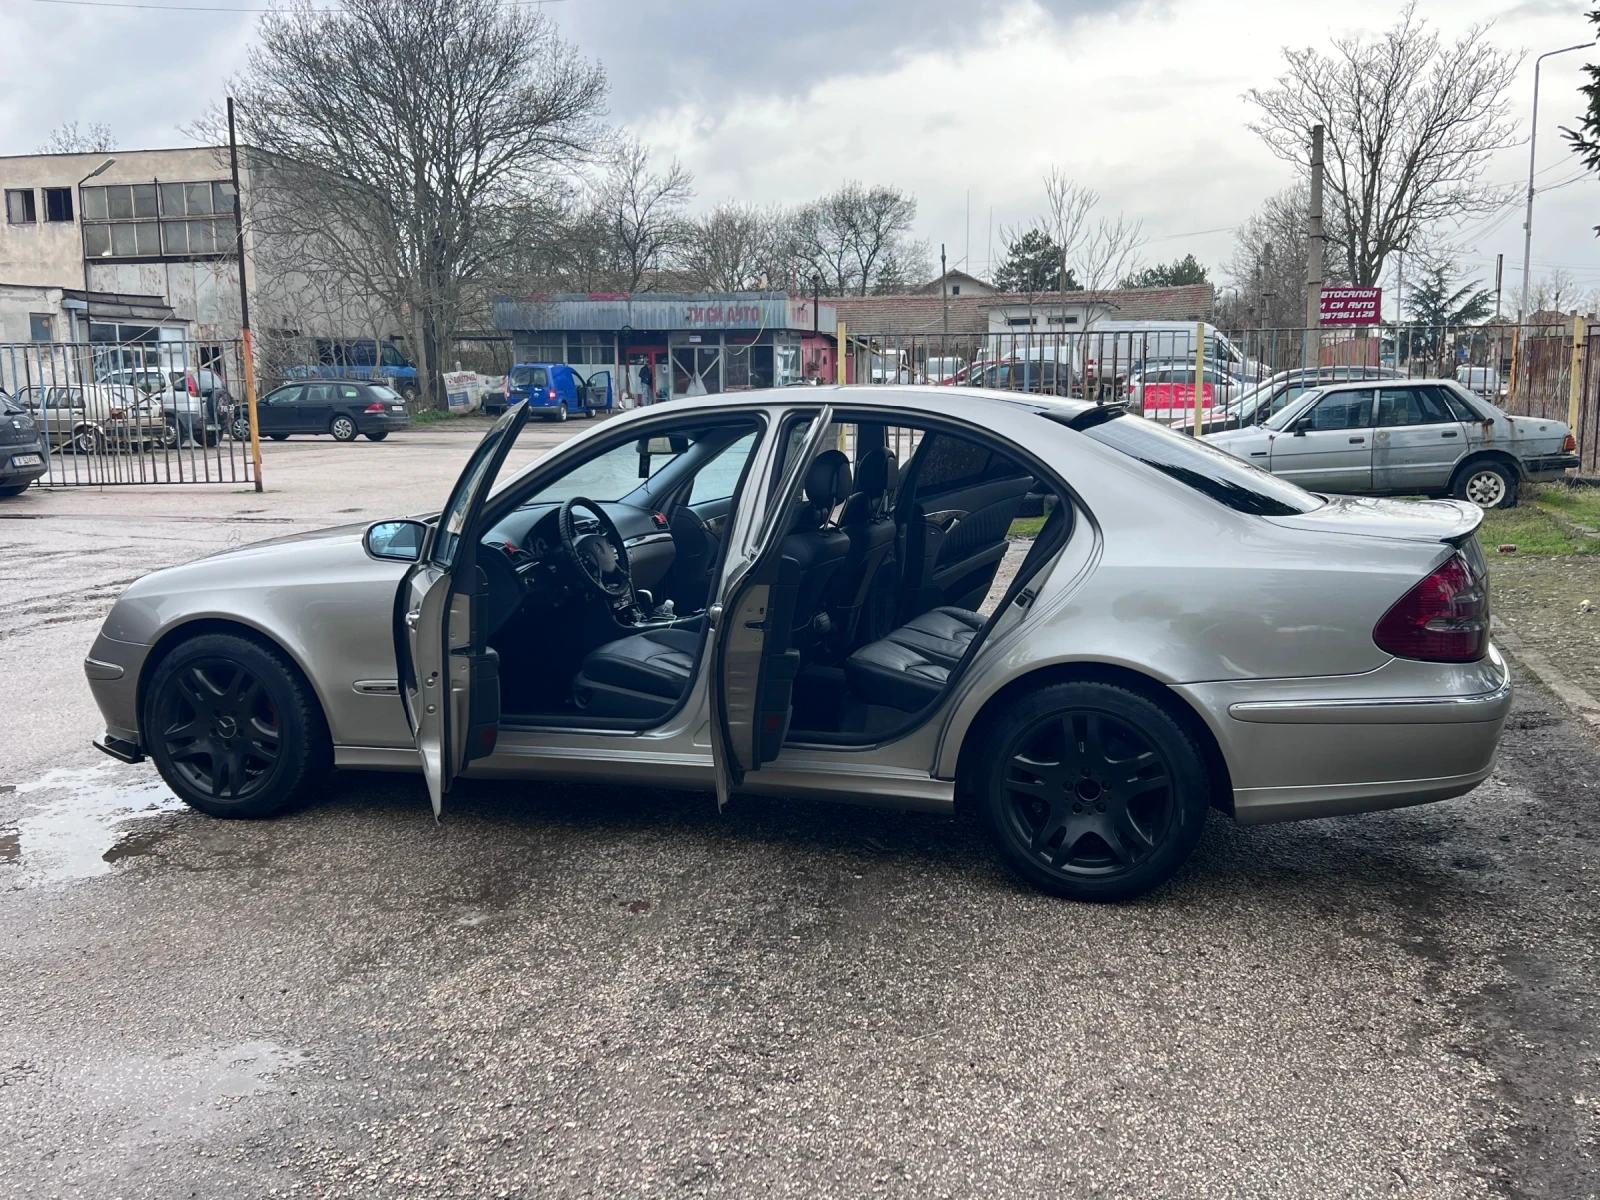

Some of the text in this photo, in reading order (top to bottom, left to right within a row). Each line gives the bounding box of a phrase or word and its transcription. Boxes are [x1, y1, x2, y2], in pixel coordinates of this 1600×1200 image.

[1320, 290, 1377, 299] ВТОСАЛОН
[1330, 301, 1344, 309] СИ
[1347, 301, 1375, 309] АУТО
[727, 305, 759, 323] АУТО
[1320, 310, 1375, 320] 897961128
